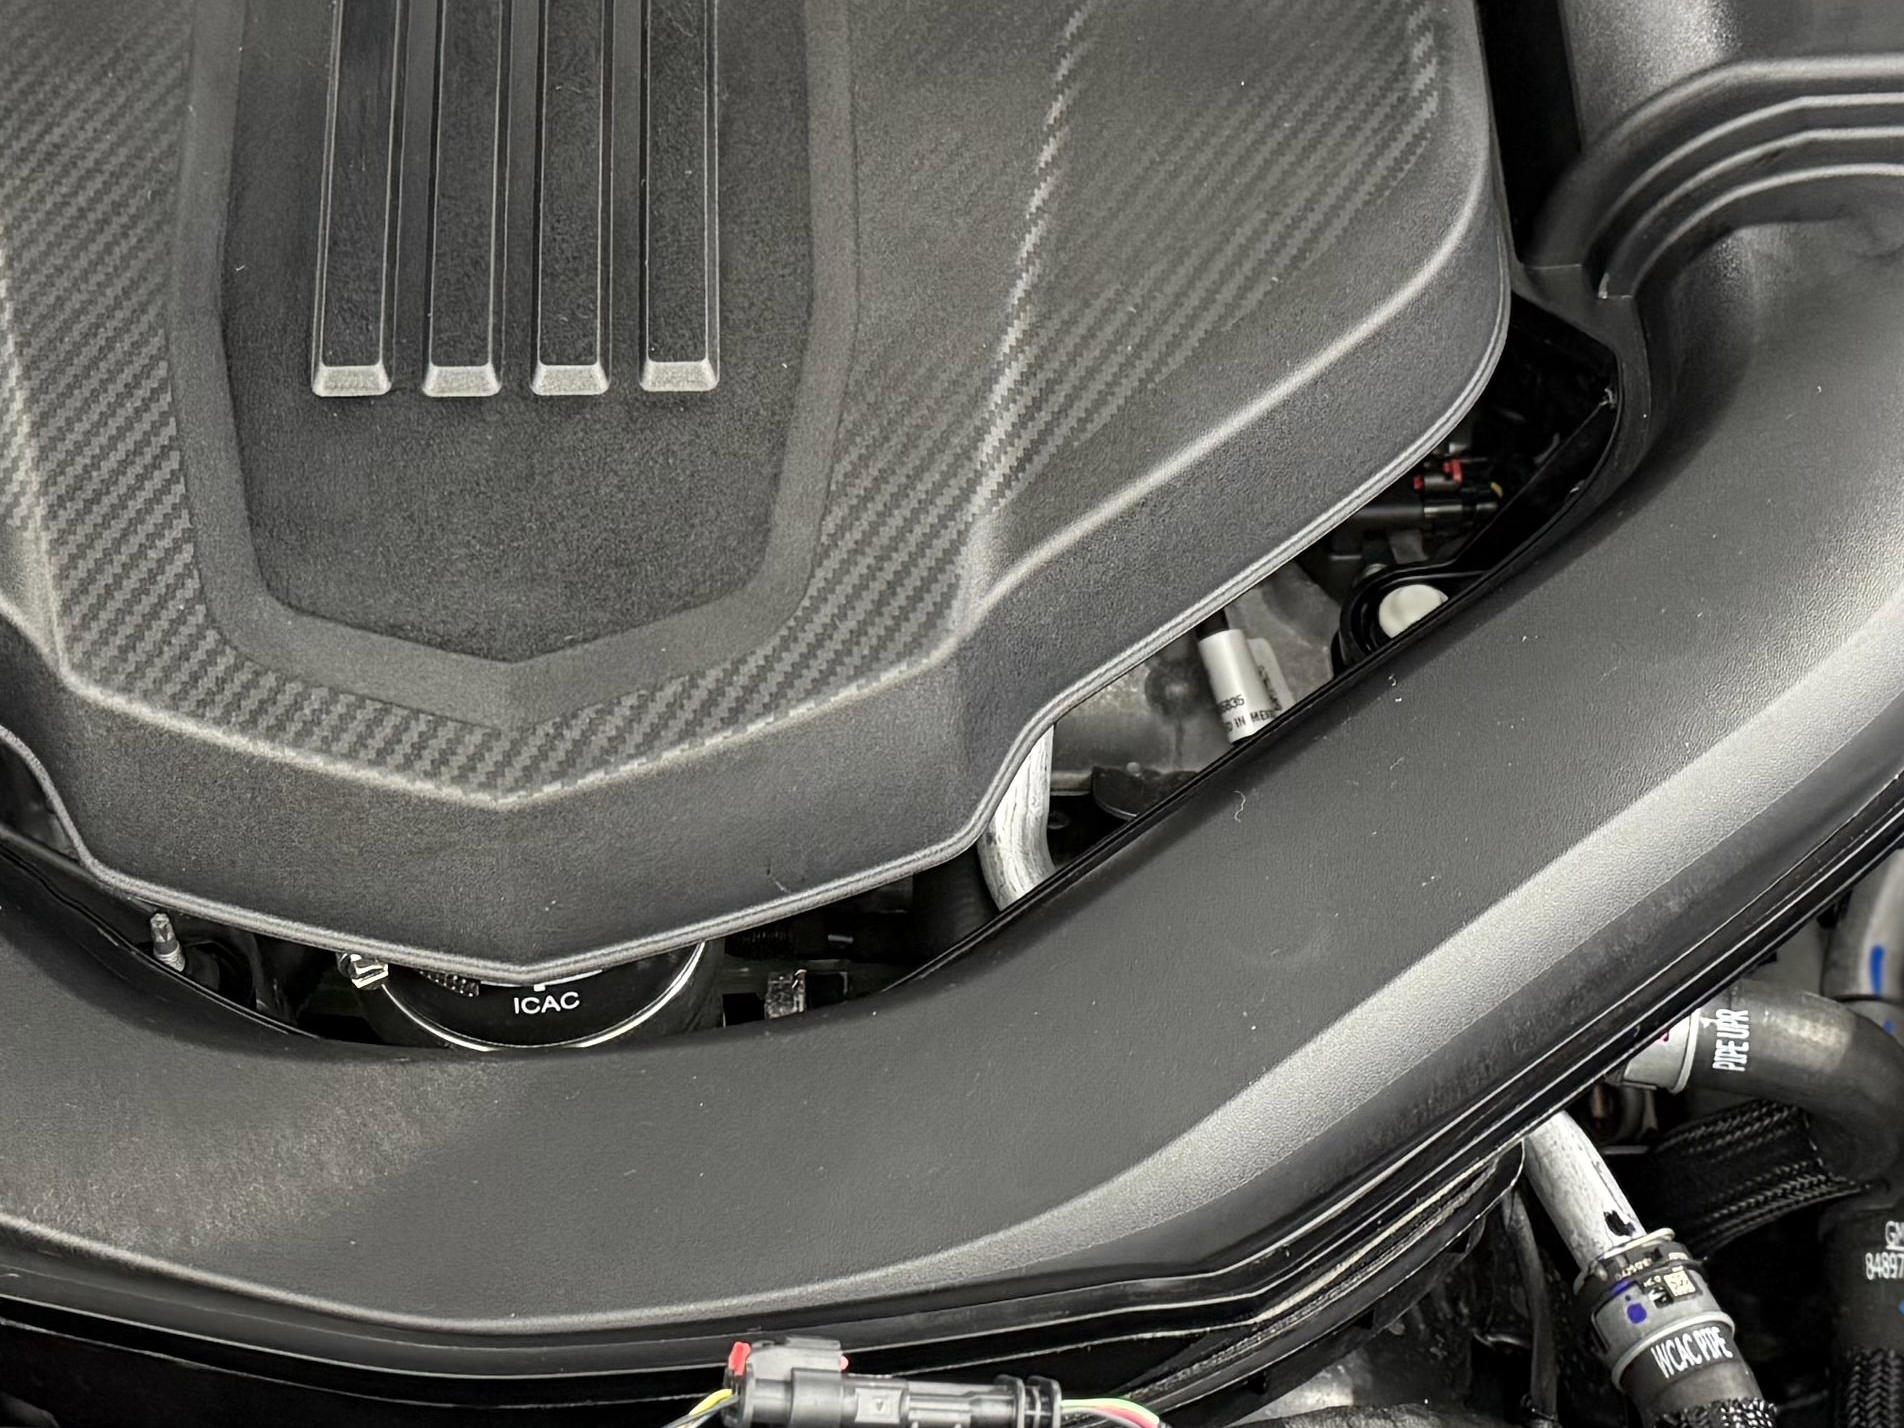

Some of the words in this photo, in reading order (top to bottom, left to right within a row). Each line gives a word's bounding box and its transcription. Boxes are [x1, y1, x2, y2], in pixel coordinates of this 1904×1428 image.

[514, 991, 580, 1014] ICAC
[1716, 1008, 1750, 1040] UPR
[1712, 1039, 1750, 1071] PIPE
[1651, 1333, 1702, 1379] WCAC
[1694, 1326, 1733, 1361] PIPE
